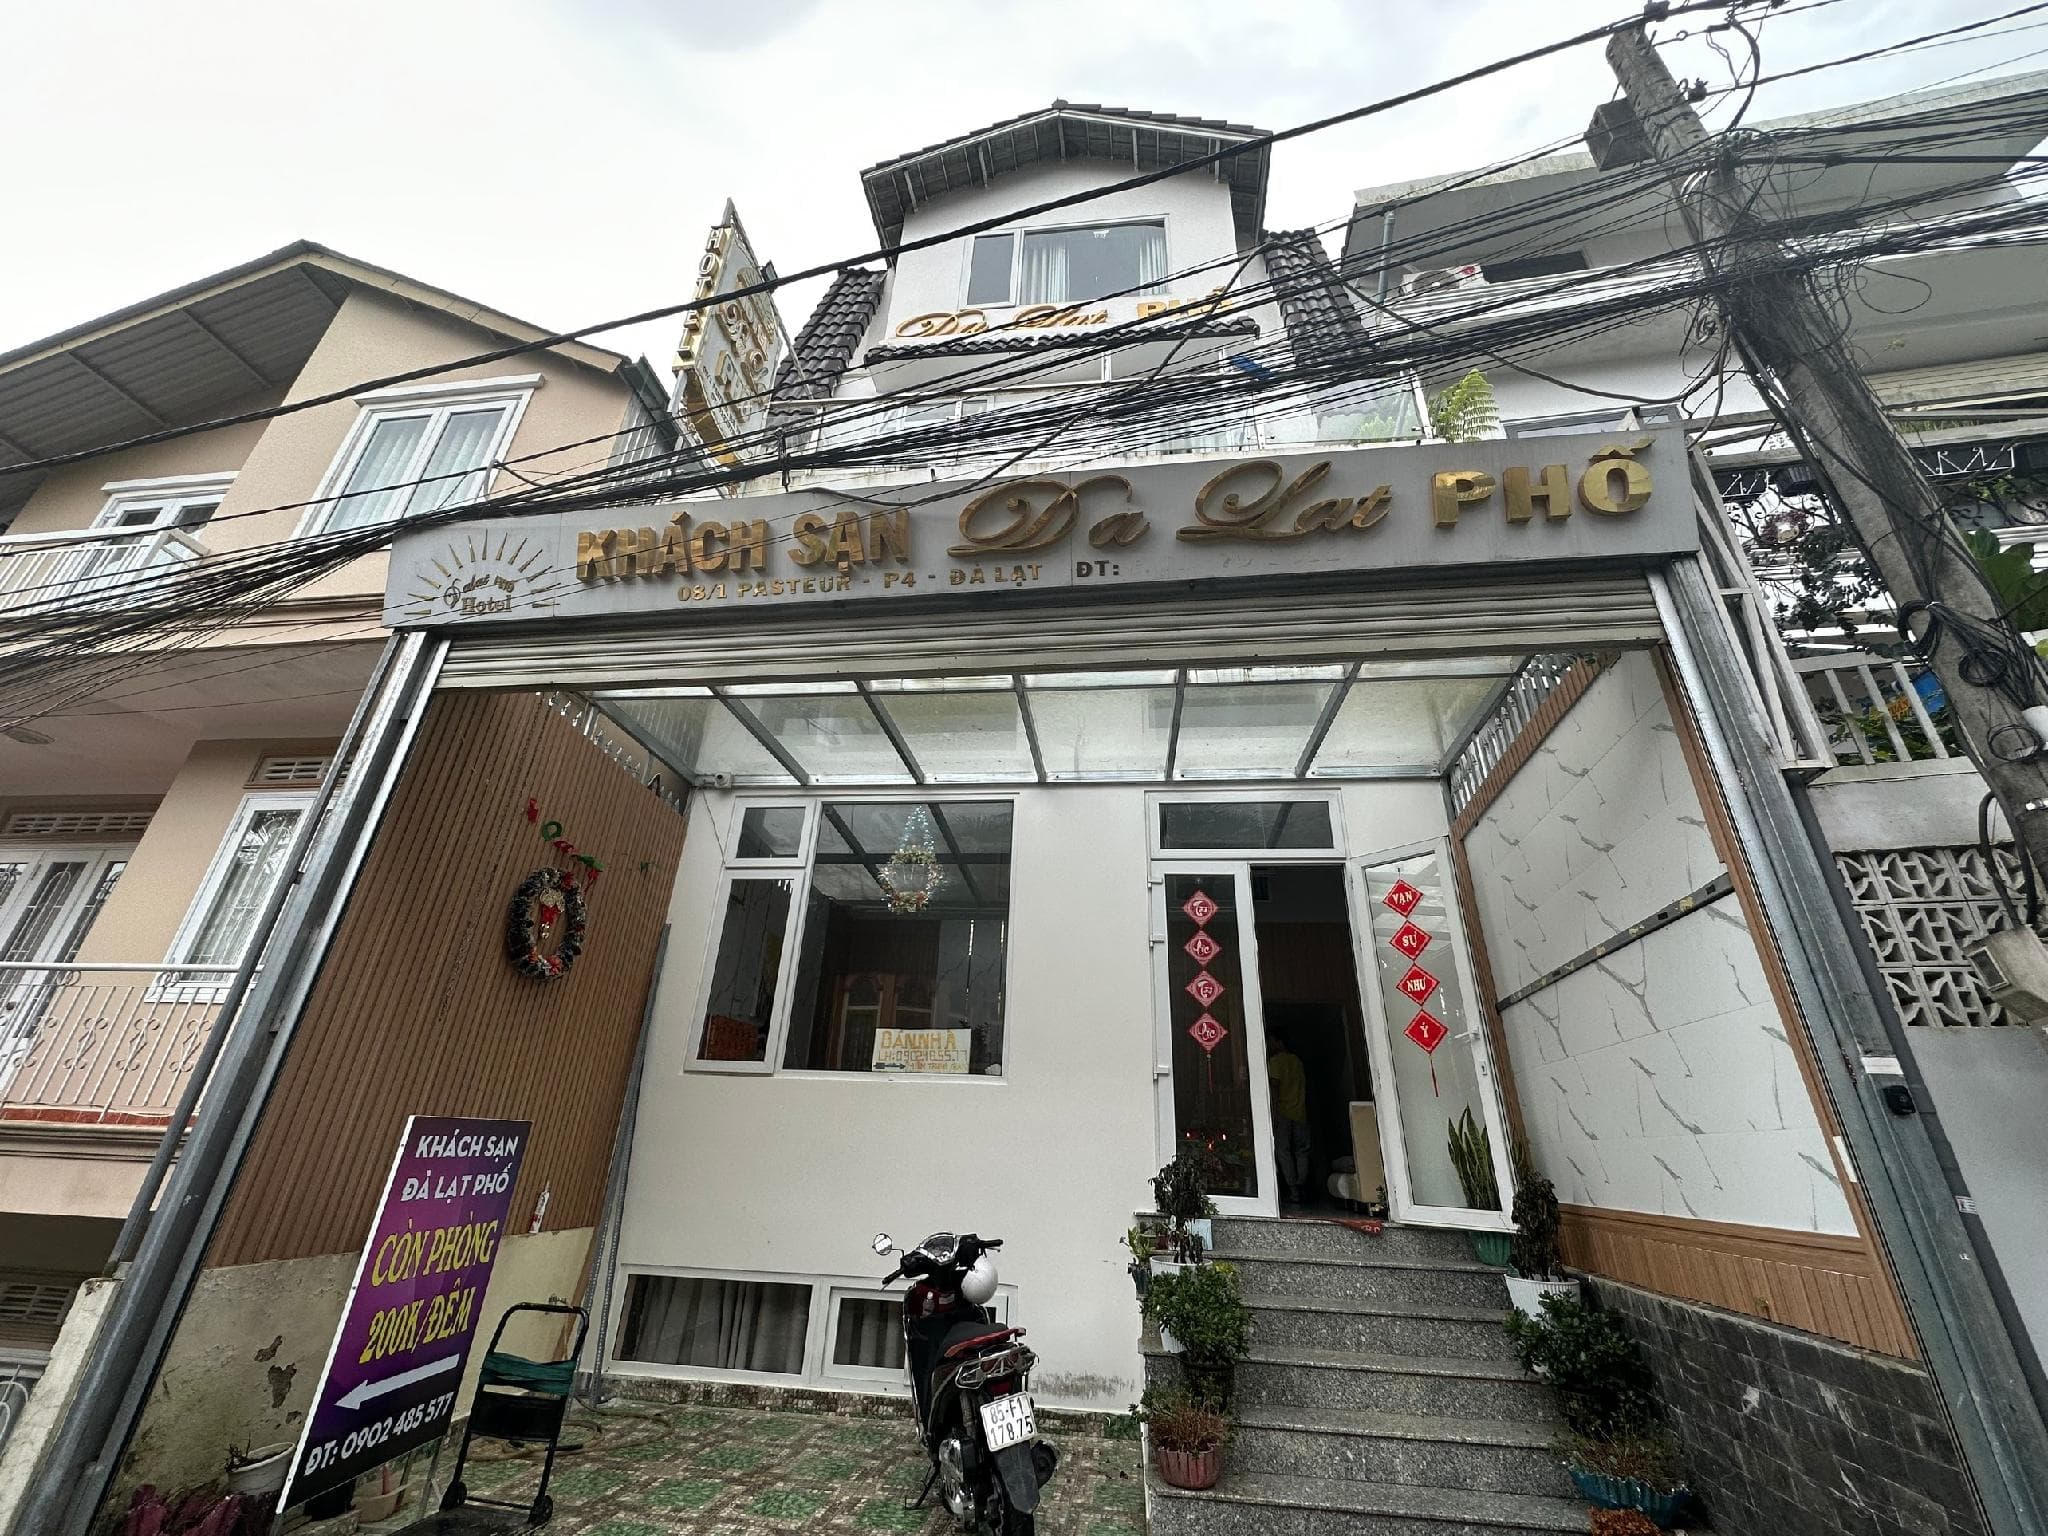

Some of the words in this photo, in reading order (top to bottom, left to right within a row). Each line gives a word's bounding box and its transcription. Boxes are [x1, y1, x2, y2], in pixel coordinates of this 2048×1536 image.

[679, 229, 720, 352] HOTEL
[576, 511, 768, 583] KHÁCH
[788, 507, 911, 574] SẠN
[1176, 460, 1393, 541] Lat
[1431, 438, 1656, 528] PHỐ
[460, 595, 512, 614] Hotel
[678, 582, 728, 602] 08/1
[737, 574, 851, 598] PASTEUR
[884, 572, 917, 589] P4
[415, 1128, 484, 1158] KHÁCH
[484, 1135, 519, 1163] SẠN
[472, 1162, 513, 1196] PHỐ
[423, 1211, 499, 1276] PHÒNG
[304, 1439, 339, 1476] ĐT:
[341, 1416, 393, 1460] 0902
[393, 1403, 426, 1436] 485
[425, 1391, 455, 1423] 577
[990, 1416, 1034, 1447] 178.75
